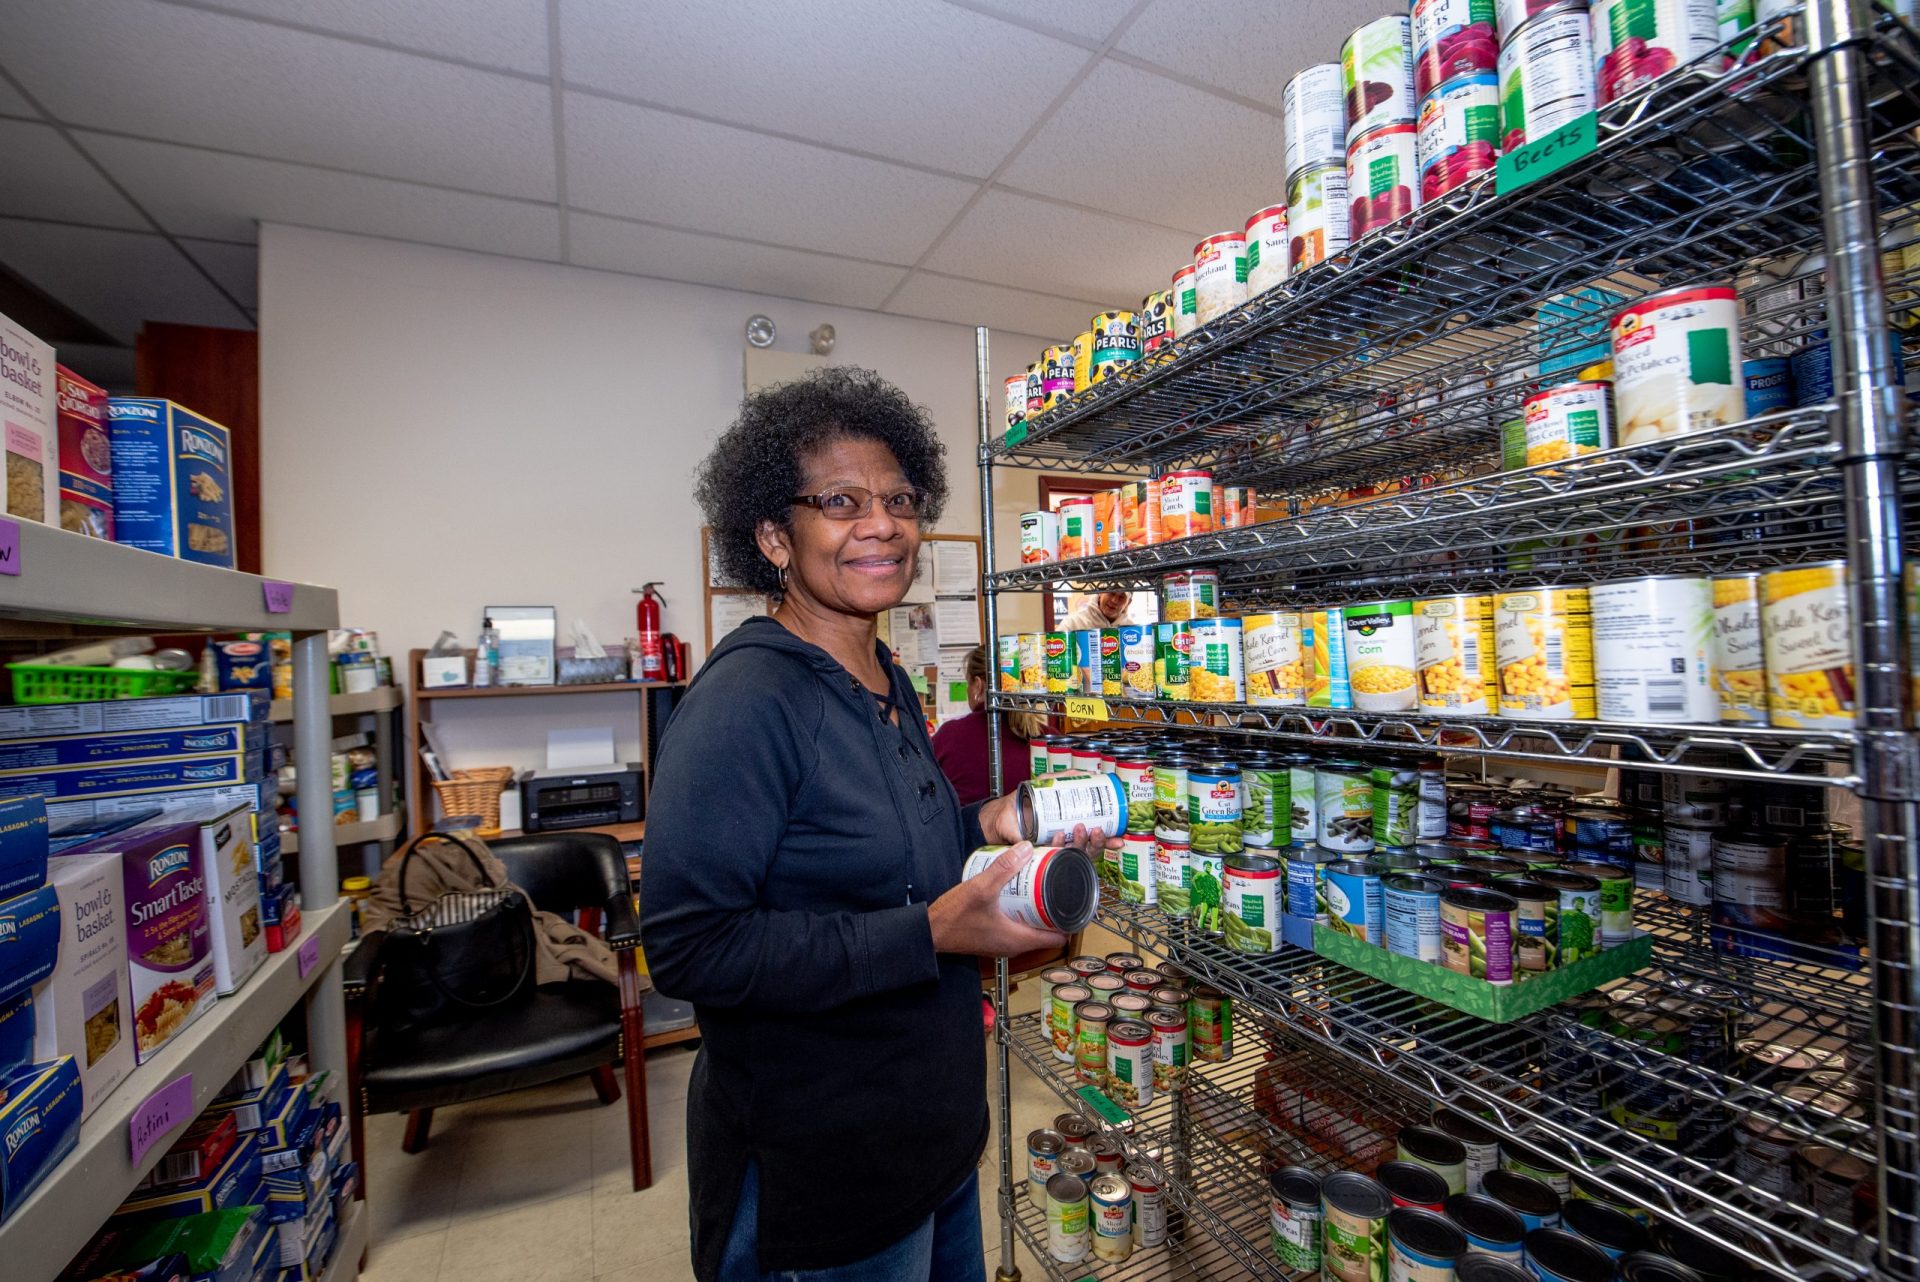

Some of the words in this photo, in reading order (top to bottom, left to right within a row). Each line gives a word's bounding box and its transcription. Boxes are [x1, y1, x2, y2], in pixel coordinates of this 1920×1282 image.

[1515, 126, 1582, 173] Beets
[1145, 320, 1165, 338] RLS
[1096, 335, 1137, 352] PEARLS
[0, 357, 44, 399] basket
[1049, 367, 1074, 380] PEAR
[1750, 373, 1787, 390] PROGRE
[108, 405, 158, 419] RONZONI
[181, 429, 224, 463] RONZONI
[1358, 645, 1382, 655] Corn
[1071, 702, 1095, 715] CORN
[184, 734, 229, 748] RONZONI
[184, 765, 228, 778] RONZONI
[1131, 790, 1152, 799] Green
[1201, 806, 1225, 815] Green
[1217, 800, 1231, 808] Cut
[0, 821, 29, 833] LASAGNA
[150, 850, 189, 881] RONZONI
[1161, 870, 1181, 881] Beans
[74, 889, 103, 921] bowl
[102, 888, 112, 906] &
[131, 888, 179, 926] Smart
[175, 876, 203, 903] Taste
[0, 920, 16, 935] ZONI
[76, 910, 114, 943] basket
[1520, 924, 1544, 933] BEANS
[0, 1010, 15, 1024] AGNA
[41, 1090, 67, 1119] LASAGNA
[136, 1101, 171, 1148] Rotini
[5, 1113, 41, 1154] RONZONI
